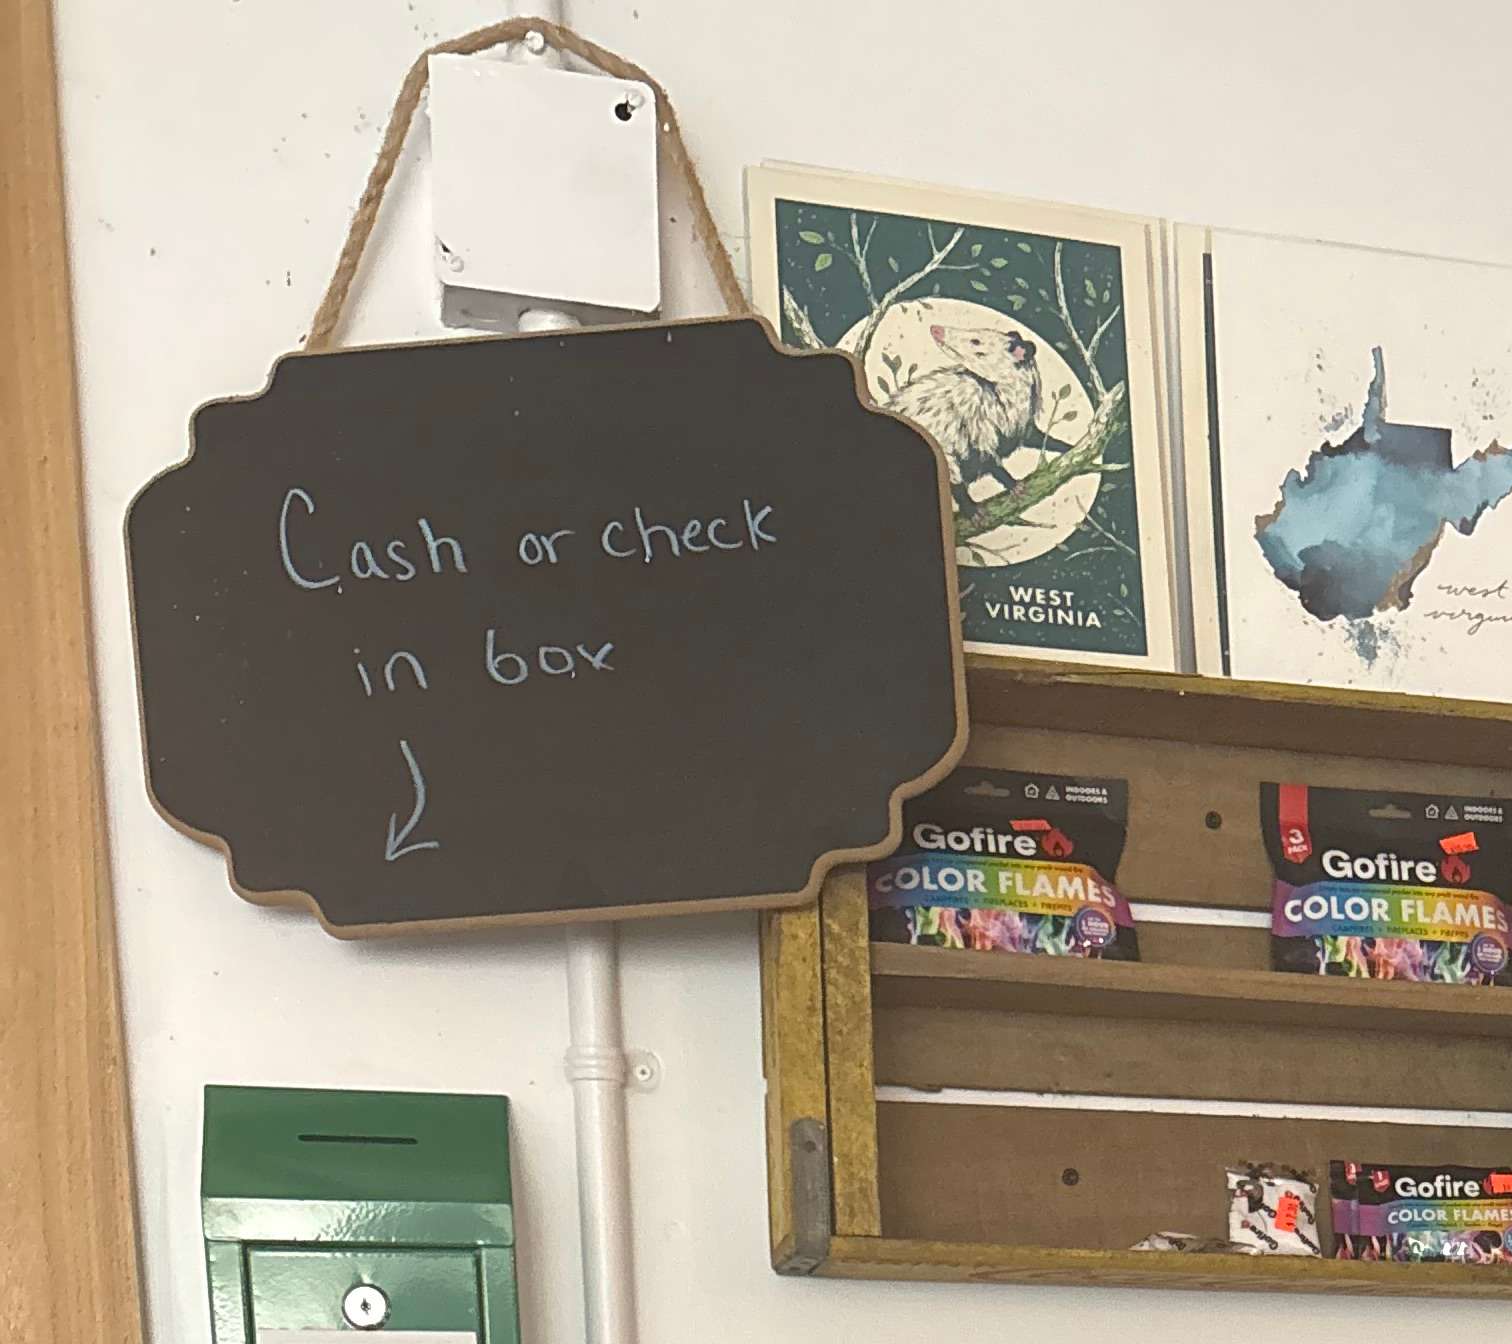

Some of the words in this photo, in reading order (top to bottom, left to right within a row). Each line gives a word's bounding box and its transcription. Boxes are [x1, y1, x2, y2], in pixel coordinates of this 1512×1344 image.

[279, 487, 467, 590] Cash
[518, 530, 572, 566] or
[601, 499, 778, 558] check
[1009, 585, 1075, 607] WEST
[1437, 580, 1509, 599] west
[985, 601, 1101, 628] VIRGINIA
[353, 648, 429, 697] in
[485, 628, 616, 686] box
[913, 823, 1037, 856] Gofire
[1287, 844, 1308, 854] PACK
[1288, 829, 1305, 844] 3
[1322, 850, 1437, 882] Gofire
[875, 866, 988, 894] COLOR
[998, 871, 1117, 908] FLAMES
[1284, 896, 1391, 922] COLOR
[1401, 899, 1509, 932] FLAMES
[1395, 1174, 1480, 1198] Gofire
[1387, 1209, 1448, 1224] COLOR
